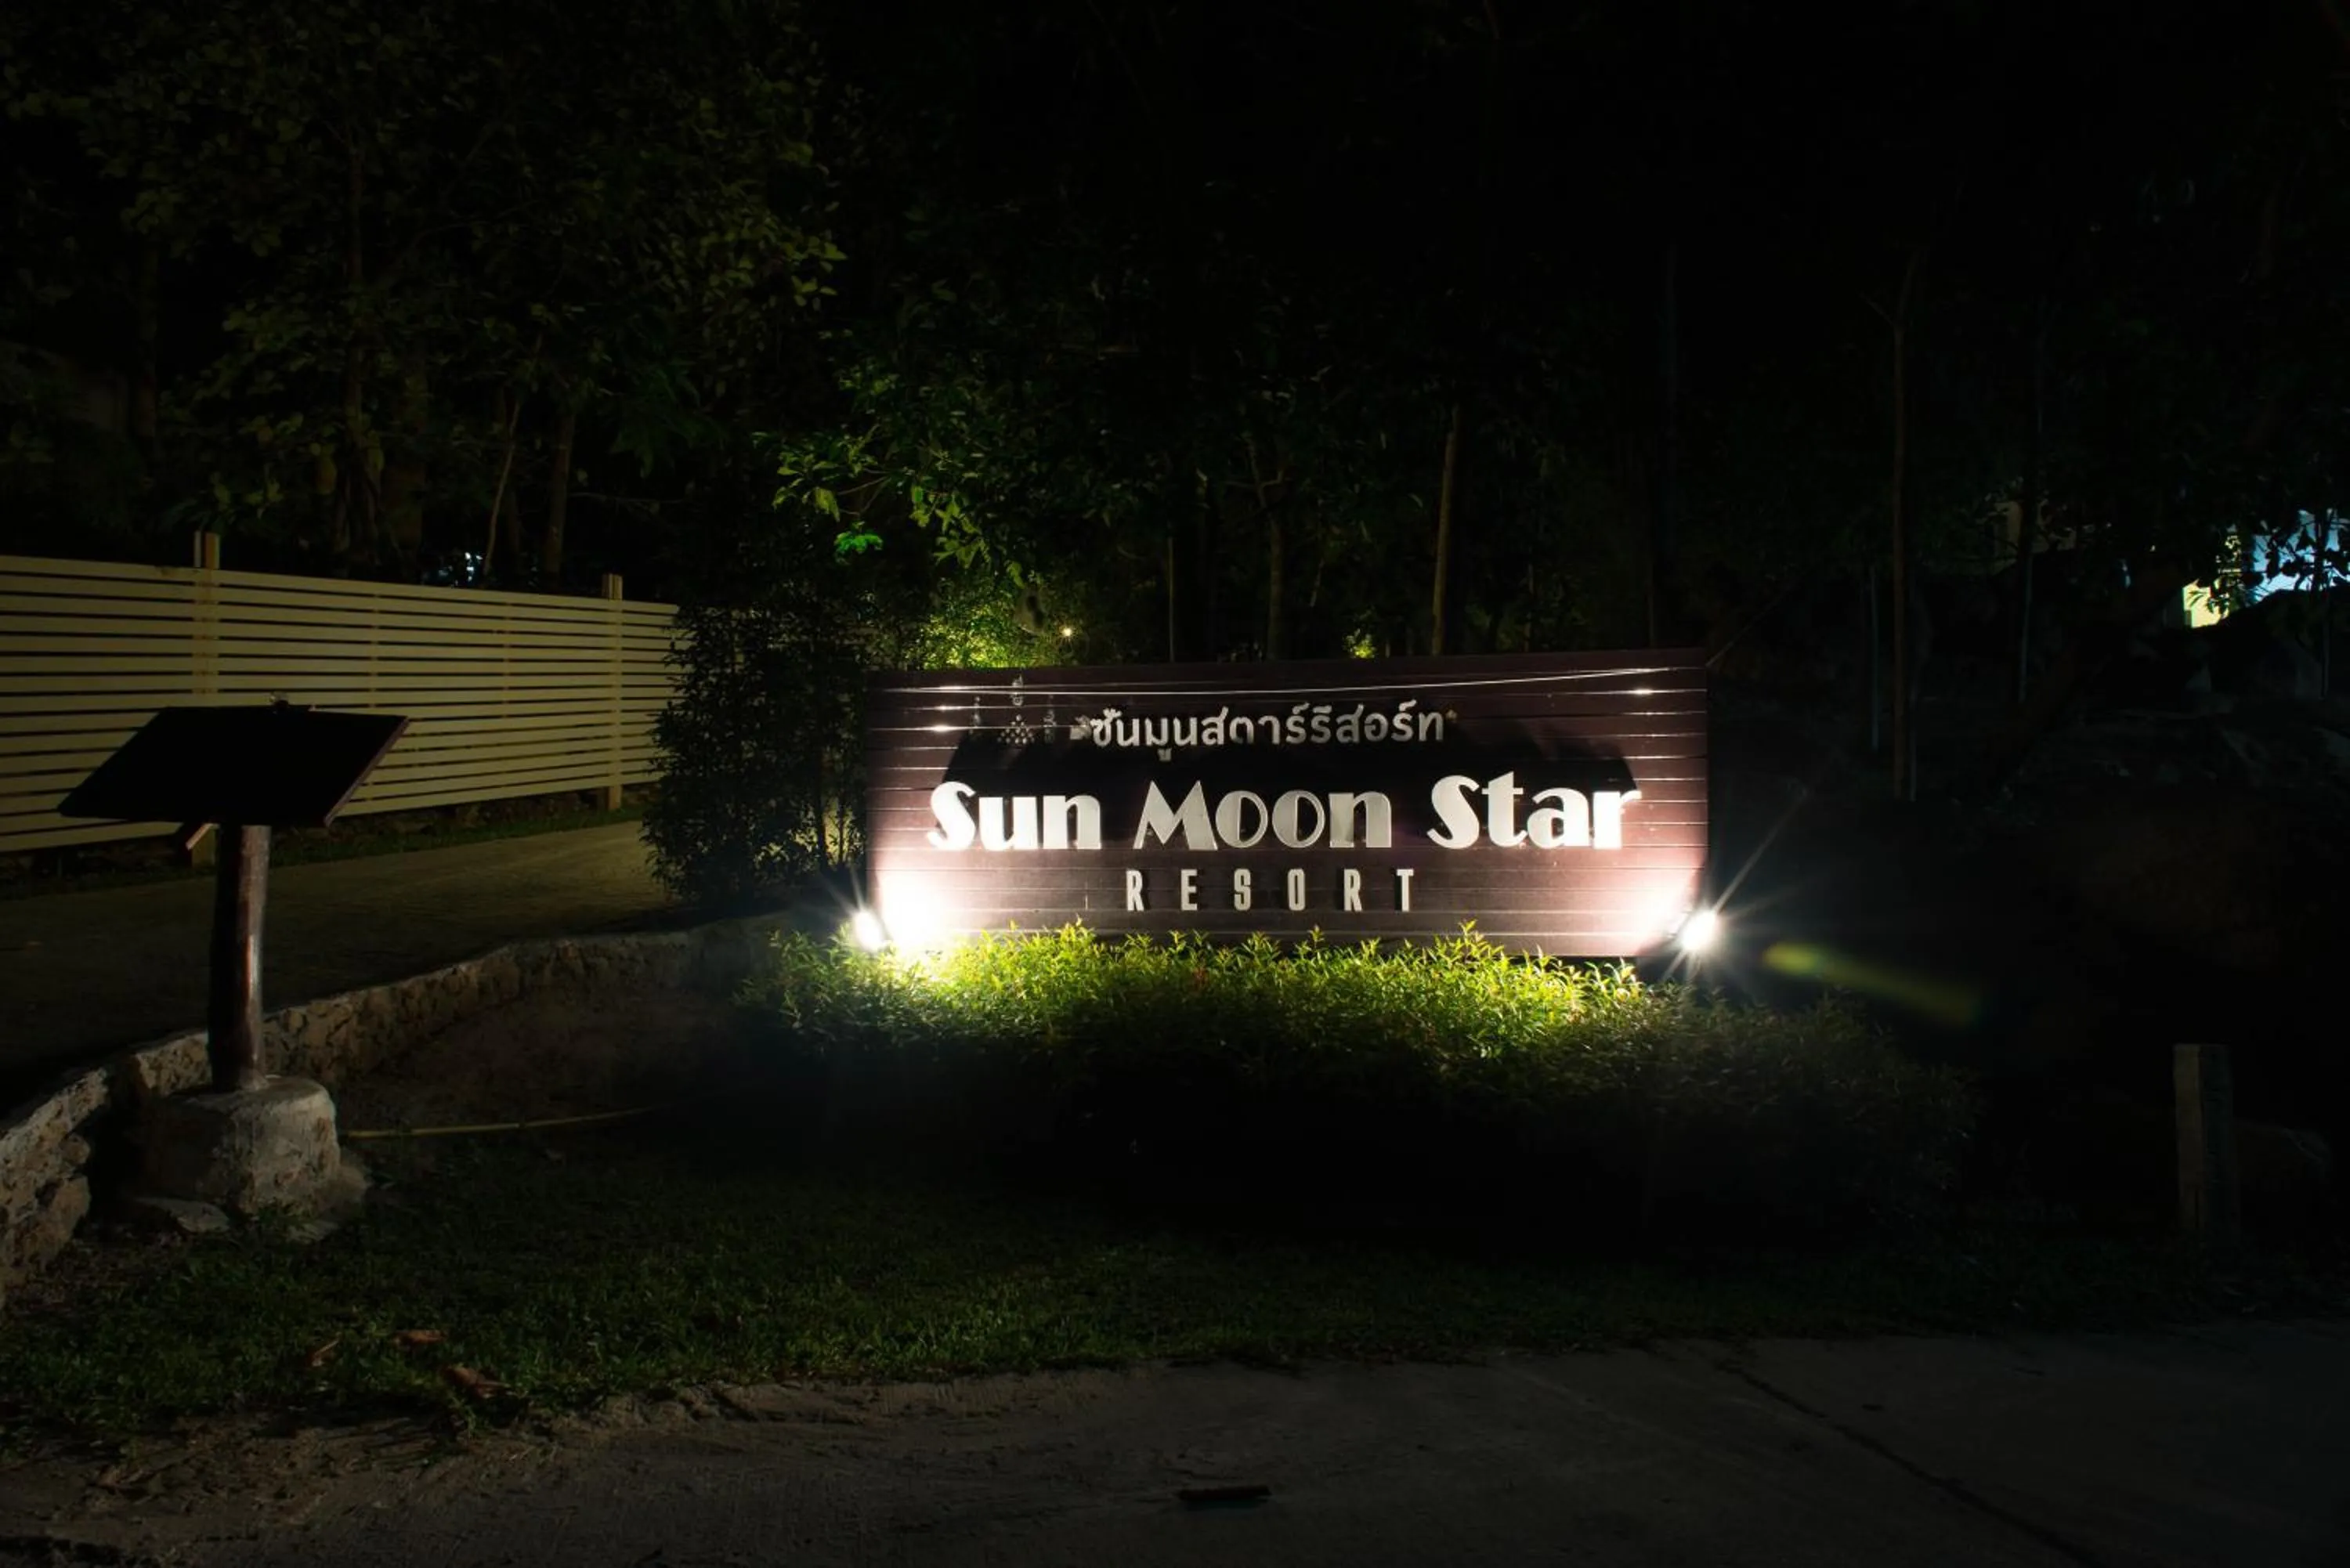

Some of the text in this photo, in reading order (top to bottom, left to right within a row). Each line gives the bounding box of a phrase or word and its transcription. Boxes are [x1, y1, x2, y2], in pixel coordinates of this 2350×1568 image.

[927, 771, 1642, 851] Sun Moon Star
[1126, 869, 1414, 912] RESORT
